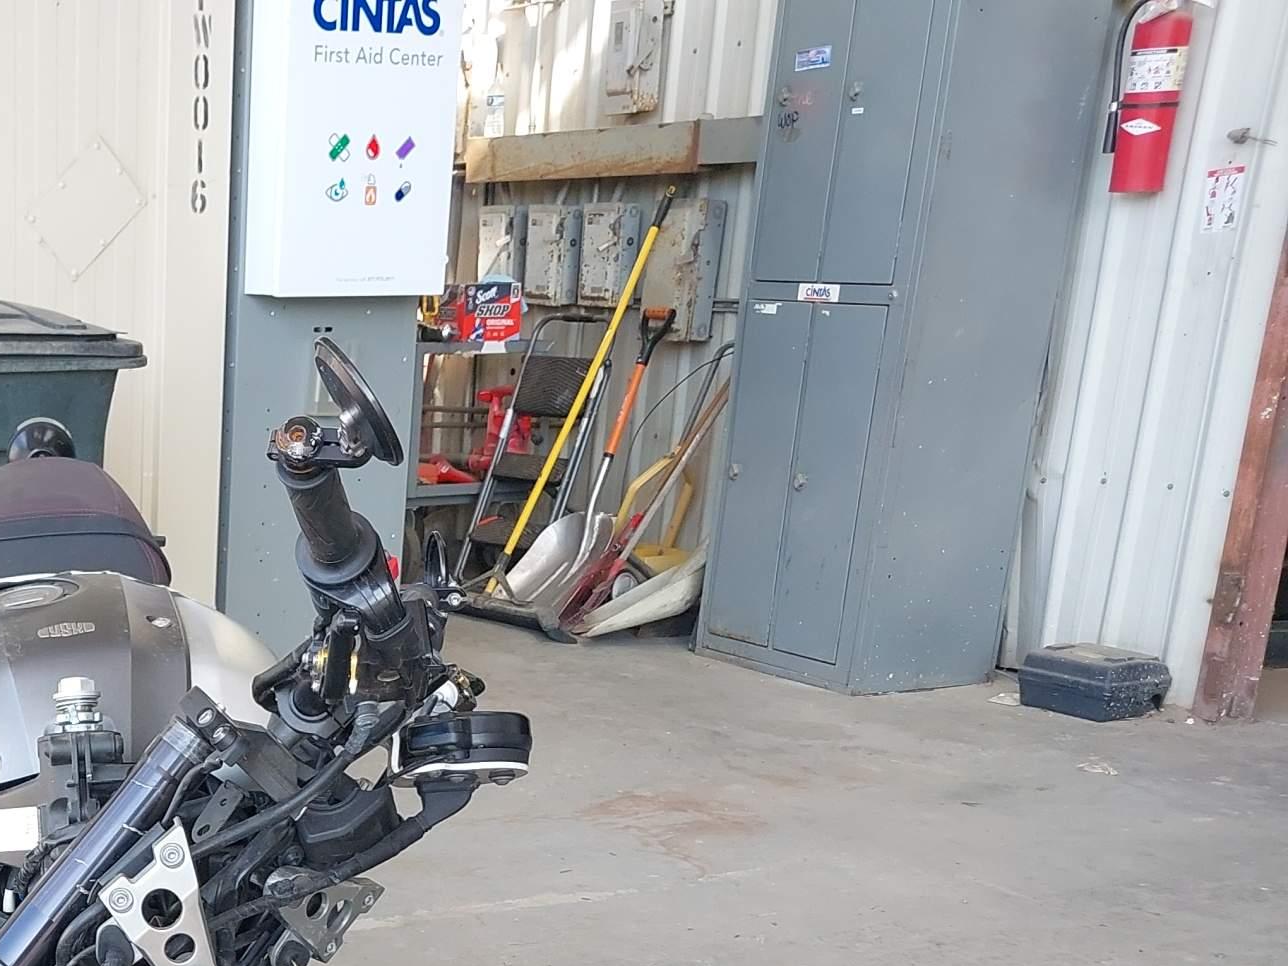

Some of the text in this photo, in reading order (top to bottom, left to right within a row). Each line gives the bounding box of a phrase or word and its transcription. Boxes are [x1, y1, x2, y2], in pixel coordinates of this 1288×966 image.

[313, 0, 441, 36] CINTAS
[314, 45, 443, 66] First Aid Center
[476, 303, 511, 317] SHOP
